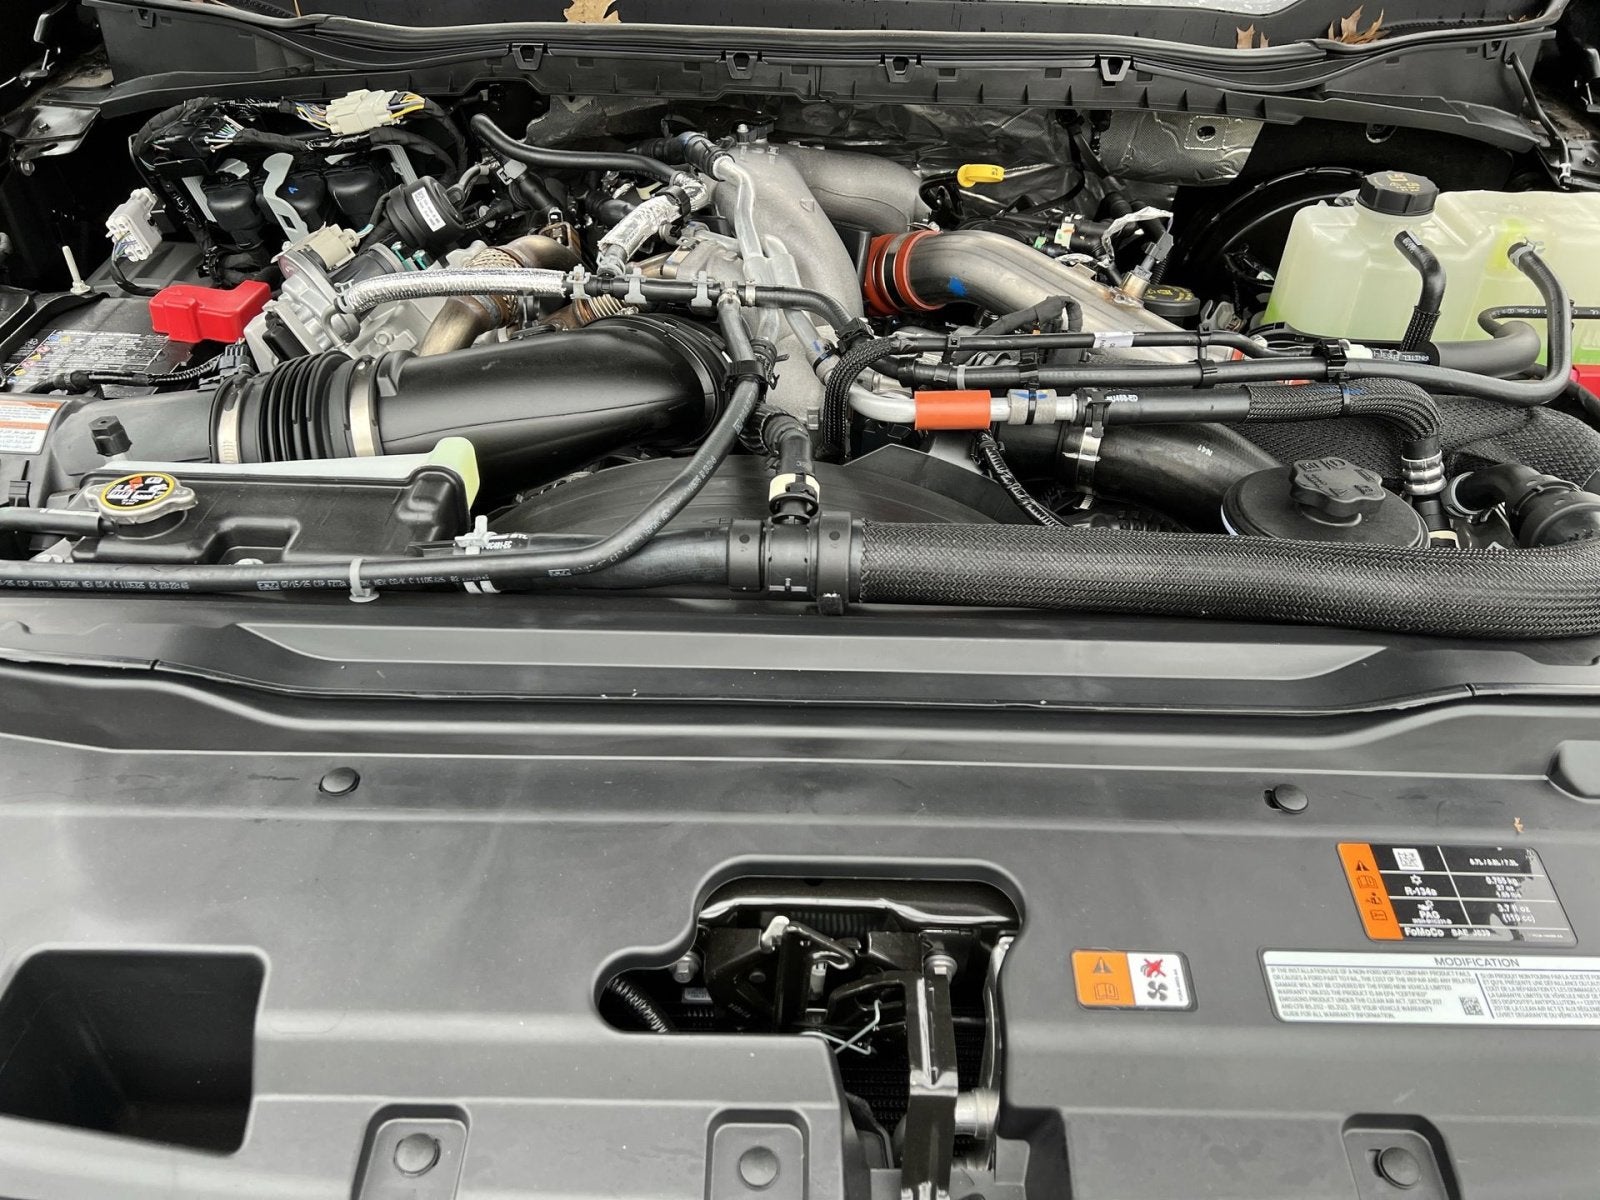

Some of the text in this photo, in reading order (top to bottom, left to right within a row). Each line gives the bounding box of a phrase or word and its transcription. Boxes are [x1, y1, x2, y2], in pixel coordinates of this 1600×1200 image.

[1419, 910, 1440, 919] PAG
[1404, 927, 1445, 937] FoMoCo
[1434, 956, 1520, 967] MODIFICATION
